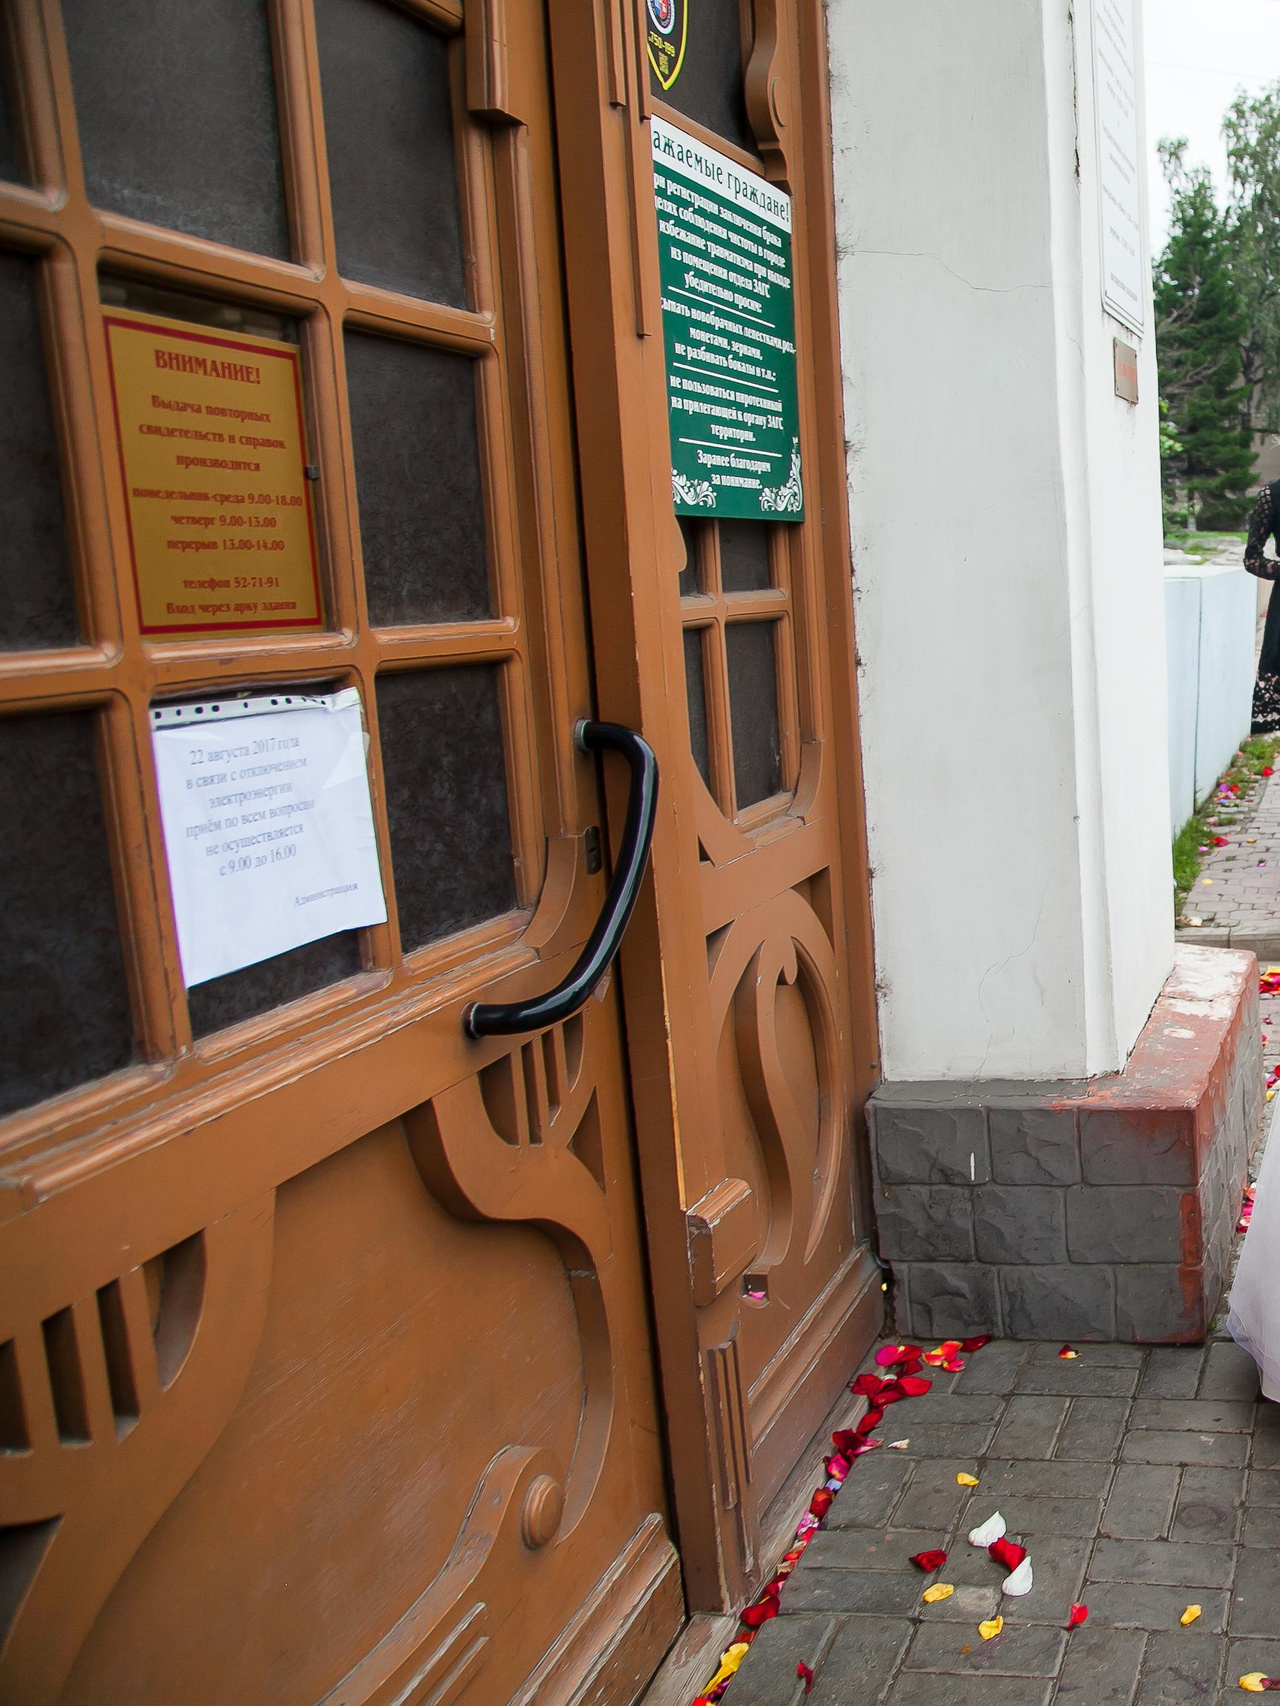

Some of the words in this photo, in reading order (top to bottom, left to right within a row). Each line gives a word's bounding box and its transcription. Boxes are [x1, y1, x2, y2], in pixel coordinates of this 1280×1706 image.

[727, 171, 790, 223] граждане!
[666, 179, 719, 215] регистрации
[719, 207, 762, 237] заключения
[762, 225, 782, 248] брака
[678, 207, 728, 239] соблюдения
[727, 230, 758, 256] чистоты
[757, 245, 763, 256] в
[763, 248, 786, 268] городе
[659, 219, 706, 250] избежание
[706, 241, 753, 271] травматизма
[753, 262, 767, 279] при
[767, 268, 791, 289] выходе
[670, 246, 682, 261] из
[682, 251, 728, 280] помещения
[728, 271, 753, 291] отдела
[752, 278, 771, 298] ЗАГС
[683, 271, 734, 302] убедительно
[690, 310, 743, 335] новобрачных
[689, 327, 730, 350] монетами,
[154, 349, 261, 384] ВНИМАНИЕ!
[674, 342, 686, 355] не
[687, 346, 728, 367] разбивать
[728, 354, 755, 375] бокалы
[669, 375, 681, 388] не
[682, 378, 735, 401] пользоваться
[735, 391, 782, 412] пиротехникой
[151, 395, 202, 415] Выдача
[206, 405, 271, 424] повторных
[670, 396, 682, 409] на
[682, 398, 737, 420] прилегающей
[737, 410, 743, 421] к
[743, 412, 767, 429] органу
[767, 415, 783, 430] ЗАГС
[139, 423, 225, 443] свидетельств
[228, 433, 236, 444] и
[239, 434, 286, 450] справок
[710, 424, 756, 443] территории.
[176, 455, 260, 472] производится
[697, 449, 729, 468] Заранее
[729, 452, 771, 474] благодарим
[711, 474, 720, 486] за
[721, 475, 762, 489] понимание.
[247, 495, 302, 507] 9.00-18.00
[171, 515, 215, 528] четверг
[219, 516, 276, 528] 9.00-13.00
[167, 539, 219, 552] перерыв
[222, 539, 285, 551] 13.00-14.00
[183, 578, 230, 593] телефон
[234, 577, 279, 588] 52-71-91
[167, 603, 196, 616] Вход
[198, 602, 231, 614] через
[234, 601, 258, 613] арку
[261, 600, 297, 612] здания
[190, 749, 204, 765] 22
[207, 745, 250, 763] августа
[252, 738, 276, 756] 2017
[278, 737, 300, 751] года
[186, 779, 193, 790] в
[196, 773, 227, 787] связи
[230, 771, 237, 781] с
[240, 757, 307, 778] отключением
[209, 783, 293, 809] электроэнергии
[186, 818, 222, 839] приём
[225, 817, 239, 829] по
[242, 810, 266, 826] всем
[269, 799, 316, 822] вопросам
[206, 845, 220, 857] не
[221, 823, 305, 853] осуществляется
[220, 866, 226, 877] с
[228, 857, 252, 874] 9.00
[254, 856, 268, 869] до
[269, 844, 297, 864] 16.00
[295, 882, 358, 907] Администрация
